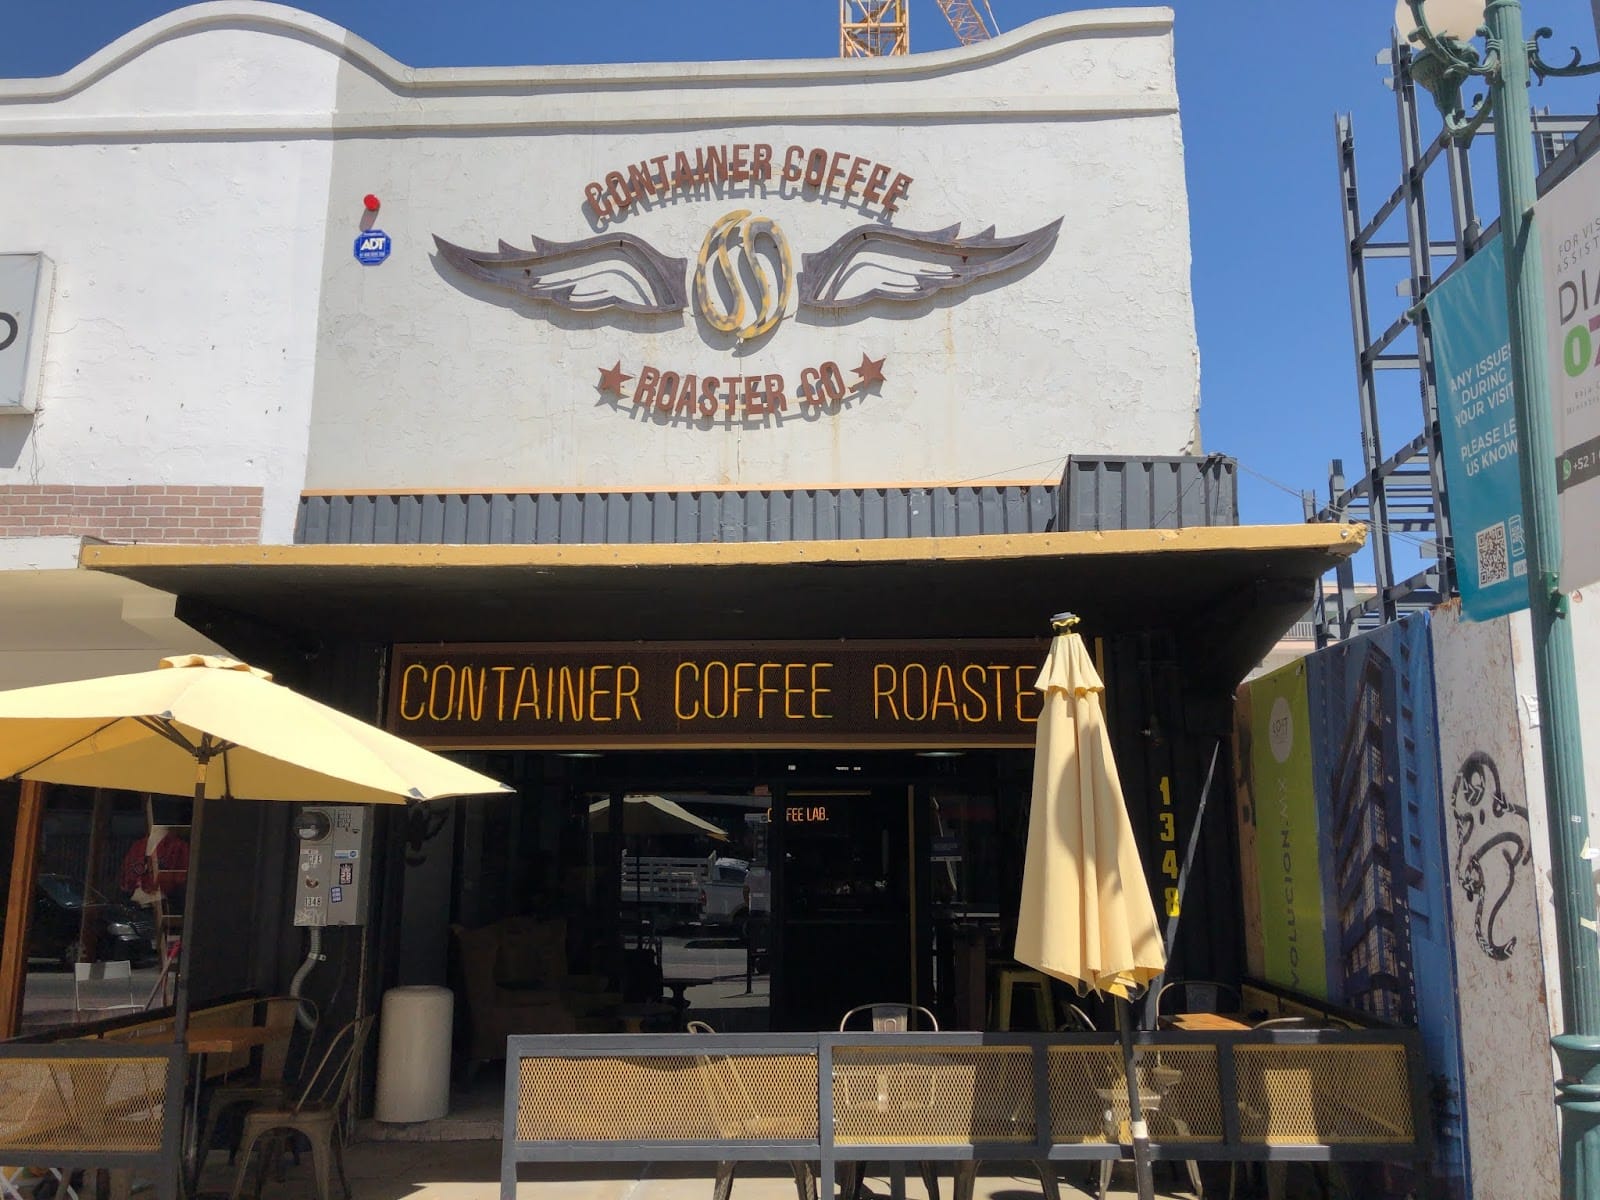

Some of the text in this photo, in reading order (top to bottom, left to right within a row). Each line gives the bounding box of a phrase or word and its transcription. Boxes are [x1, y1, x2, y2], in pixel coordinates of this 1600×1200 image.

[584, 143, 914, 218] CONTAINER COFFEE
[360, 237, 386, 251] ADT
[632, 360, 856, 418] ROASTER CO.
[1450, 367, 1473, 393] ANY
[1461, 367, 1507, 405] DURING
[1455, 382, 1514, 428] YOUR VISIT
[1461, 427, 1501, 461] PLEASE
[1466, 439, 1519, 477] US KNOW
[1573, 456, 1590, 471] +52
[400, 661, 1038, 723] CONTAINER COFFEE ROASTE
[806, 806, 829, 821] LAB.
[1159, 776, 1180, 917] 1348
